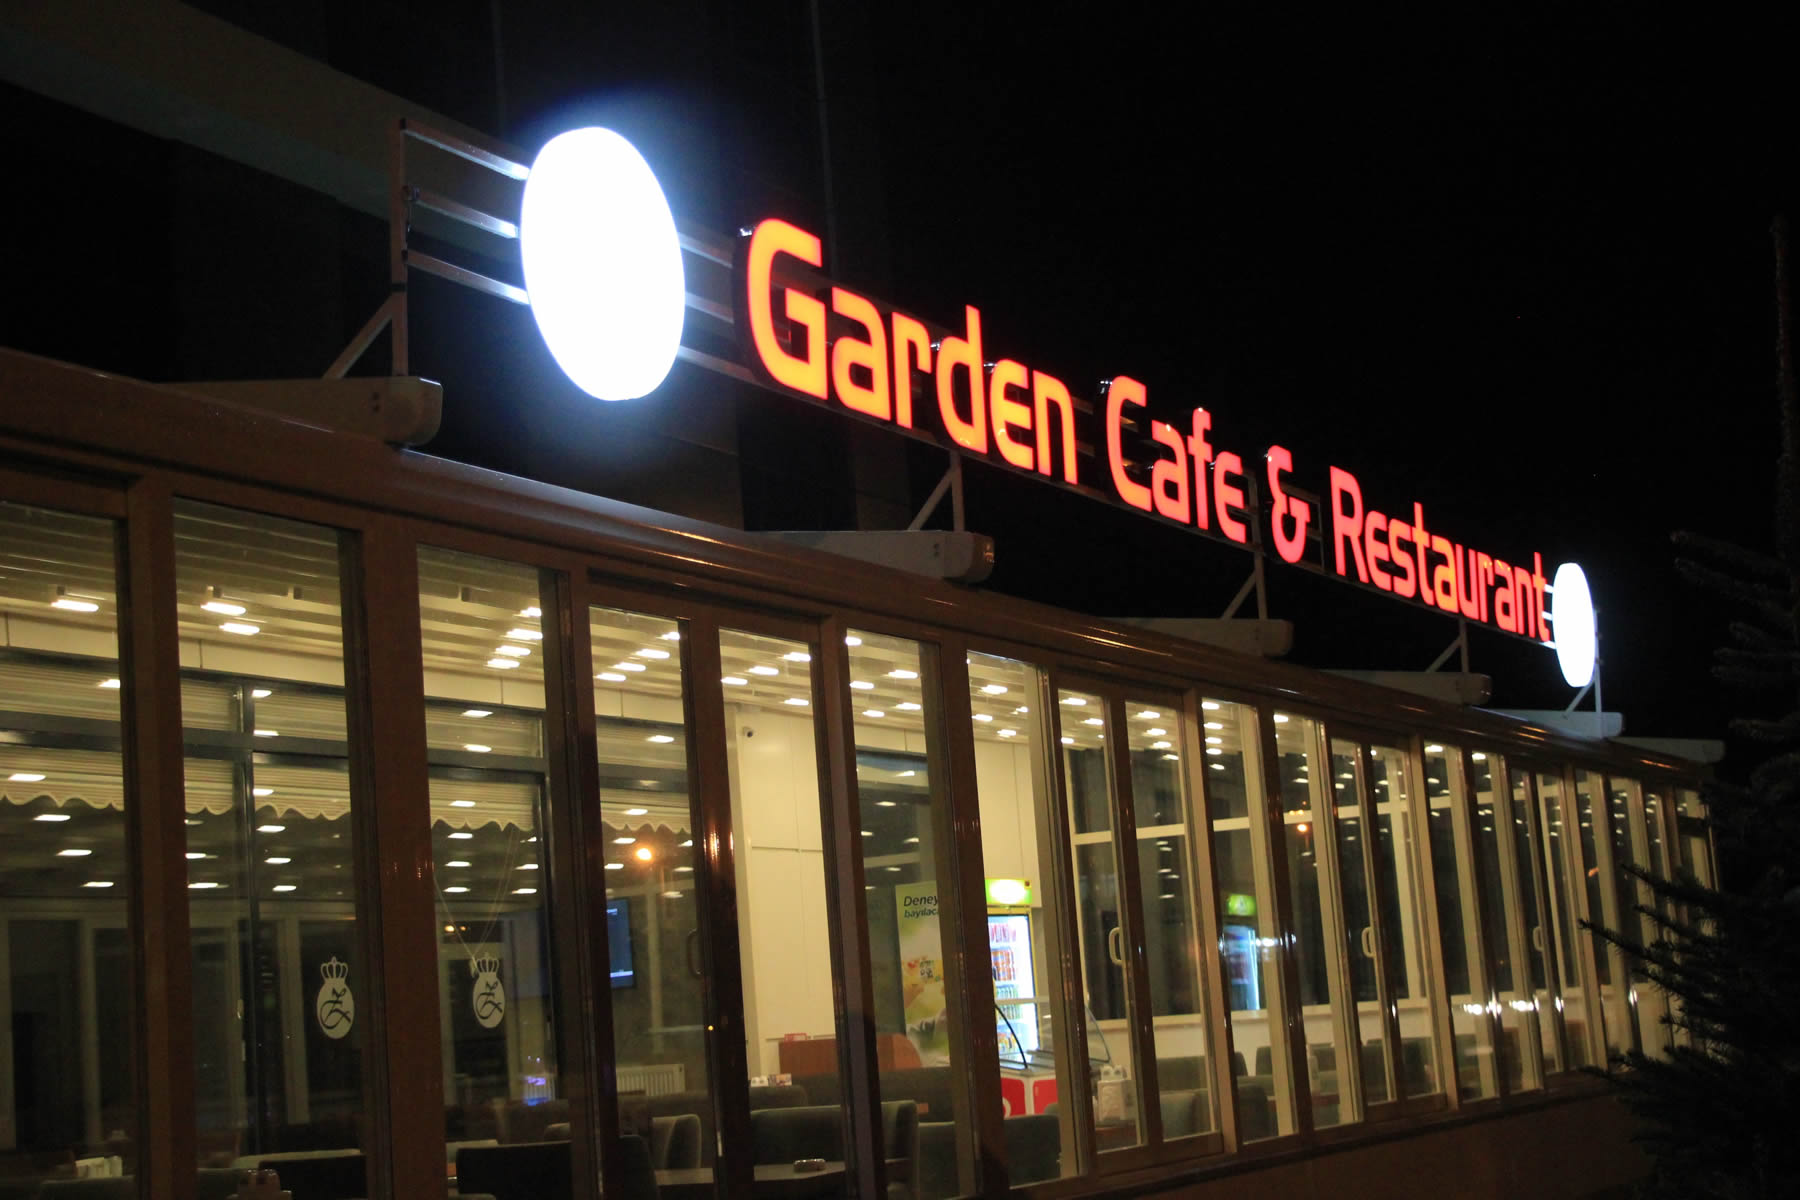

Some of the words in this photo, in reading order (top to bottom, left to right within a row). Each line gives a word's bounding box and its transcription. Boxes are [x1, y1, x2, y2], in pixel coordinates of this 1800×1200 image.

[747, 218, 1078, 485] Garden
[1106, 375, 1246, 544] Cafe
[1267, 445, 1310, 564] &
[1330, 465, 1551, 643] Restaurant
